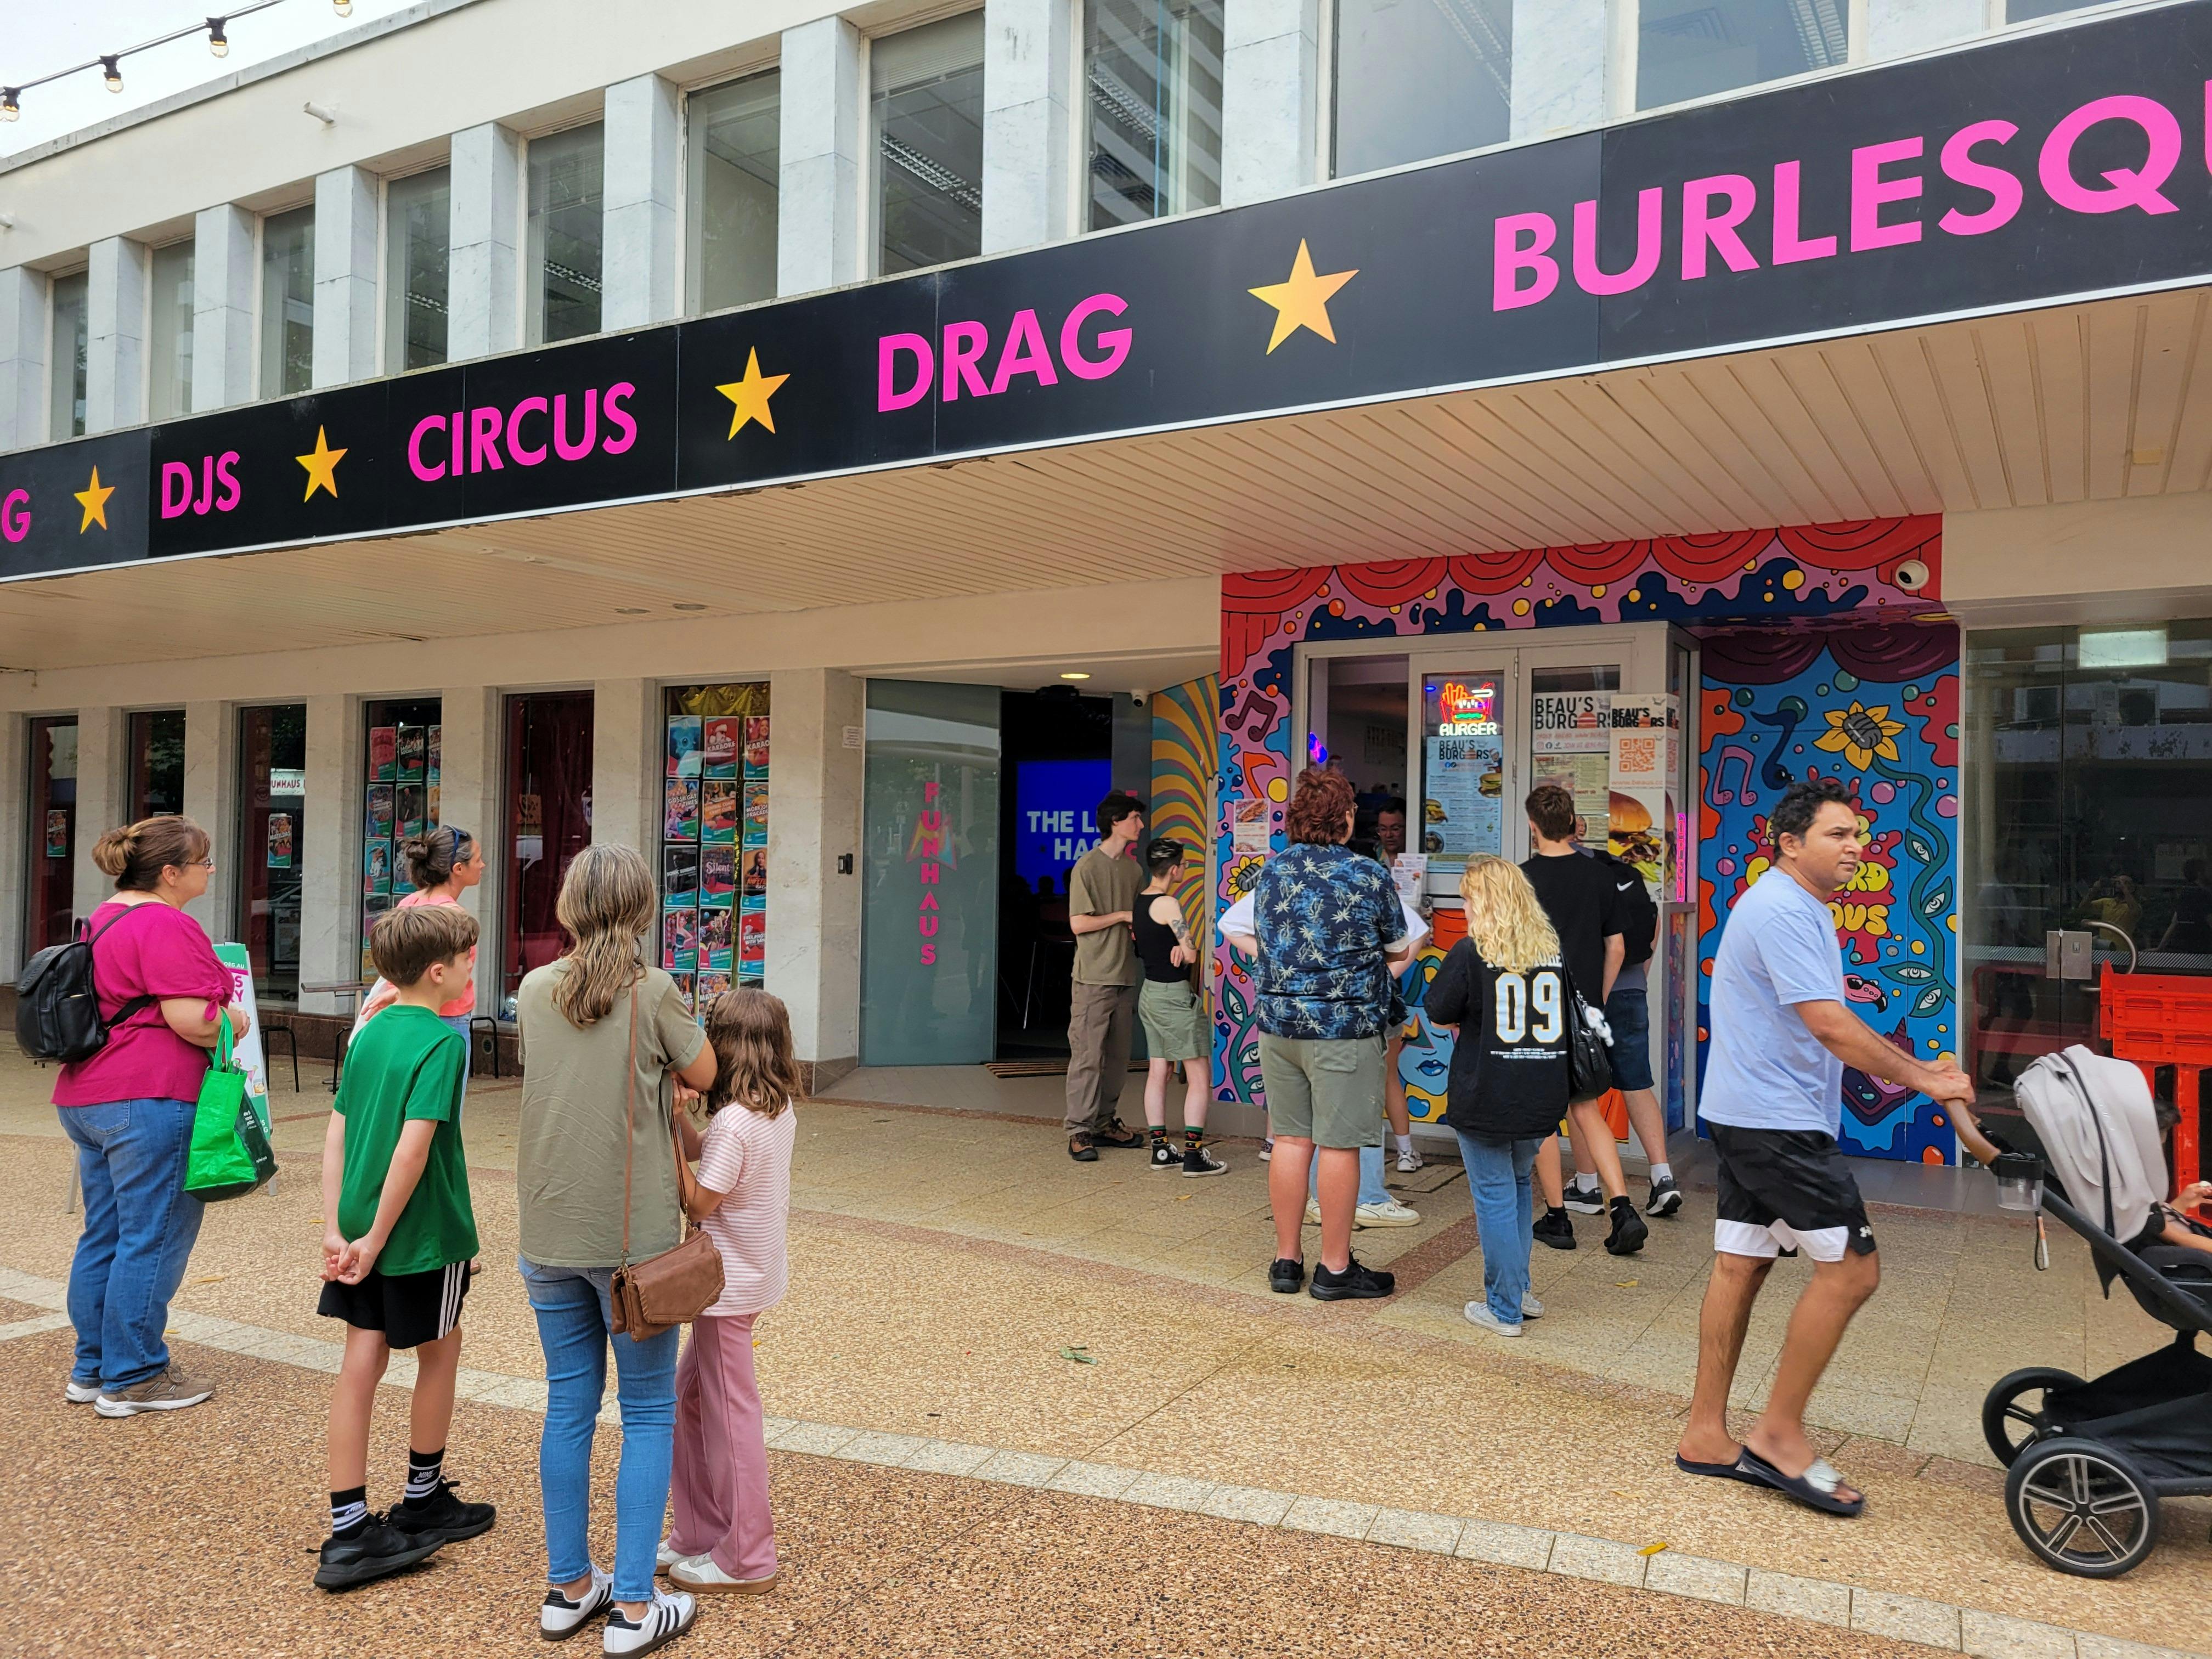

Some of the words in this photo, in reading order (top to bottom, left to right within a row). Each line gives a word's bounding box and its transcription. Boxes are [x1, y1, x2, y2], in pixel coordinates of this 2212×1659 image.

[1493, 80, 2212, 312] BURLESQ
[878, 294, 1132, 412] DRAG
[408, 382, 637, 481] CIRCUS
[162, 452, 241, 518] DJS
[1535, 696, 1594, 714] BEAU'S
[1612, 707, 1650, 718] BEAU'S
[1535, 712, 1610, 729] BURGR
[1612, 716, 1664, 727] BURGRS
[707, 741, 736, 752] KARAOKE
[1439, 740, 1475, 750] BEAU'S
[1439, 748, 1489, 760] BURGRS
[1027, 811, 1074, 832] THE
[1082, 811, 1101, 832] L
[706, 861, 730, 874] Silent
[919, 782, 940, 965] FUNHAUS
[1496, 972, 1562, 1043] 09
[418, 1470, 434, 1479] NIKE
